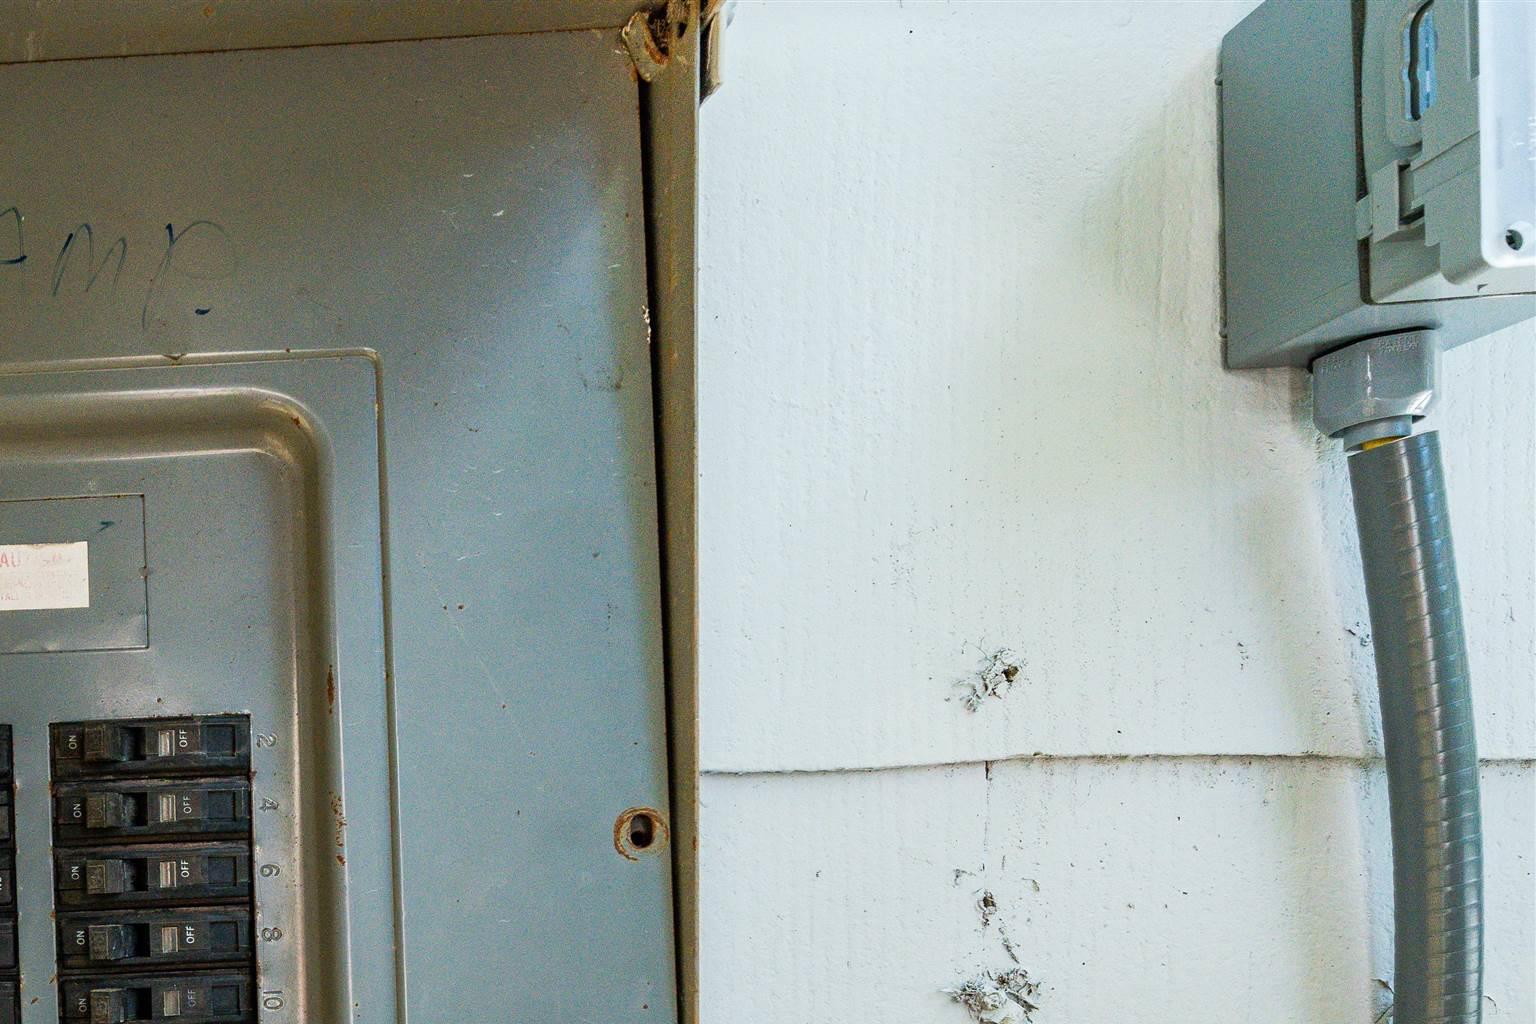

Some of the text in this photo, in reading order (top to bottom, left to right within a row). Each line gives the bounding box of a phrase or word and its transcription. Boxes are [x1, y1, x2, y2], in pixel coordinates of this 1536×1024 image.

[69, 735, 77, 750] ON
[179, 729, 187, 748] OFF
[73, 803, 82, 818] ON
[183, 796, 192, 814] OFF
[71, 865, 80, 880] ON
[181, 860, 190, 878] OFF
[76, 930, 85, 945] ON
[186, 926, 195, 944] OFF
[79, 998, 88, 1013] ON
